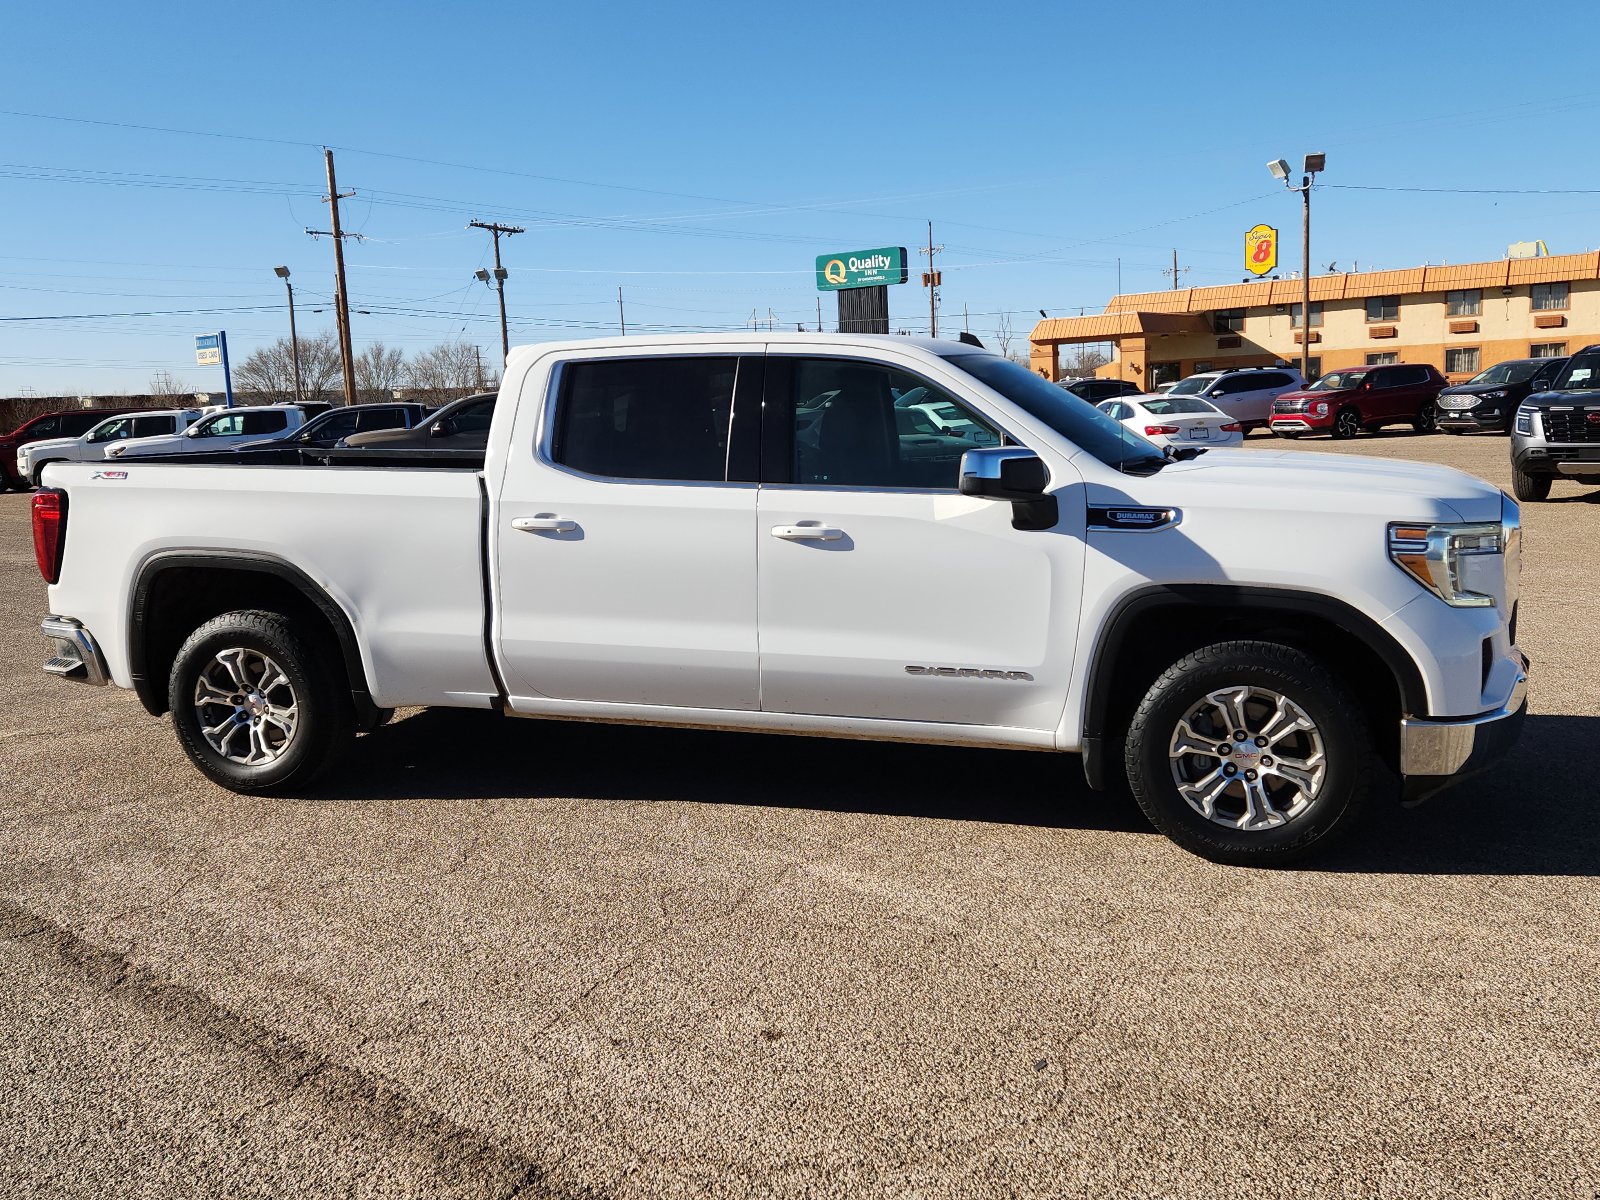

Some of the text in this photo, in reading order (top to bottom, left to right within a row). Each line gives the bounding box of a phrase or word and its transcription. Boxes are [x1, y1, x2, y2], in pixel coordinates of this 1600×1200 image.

[1248, 230, 1272, 246] Super
[1252, 240, 1272, 263] 8
[848, 254, 891, 272] Quality
[1116, 512, 1156, 520] DURAMAX
[1234, 752, 1258, 760] GMC
